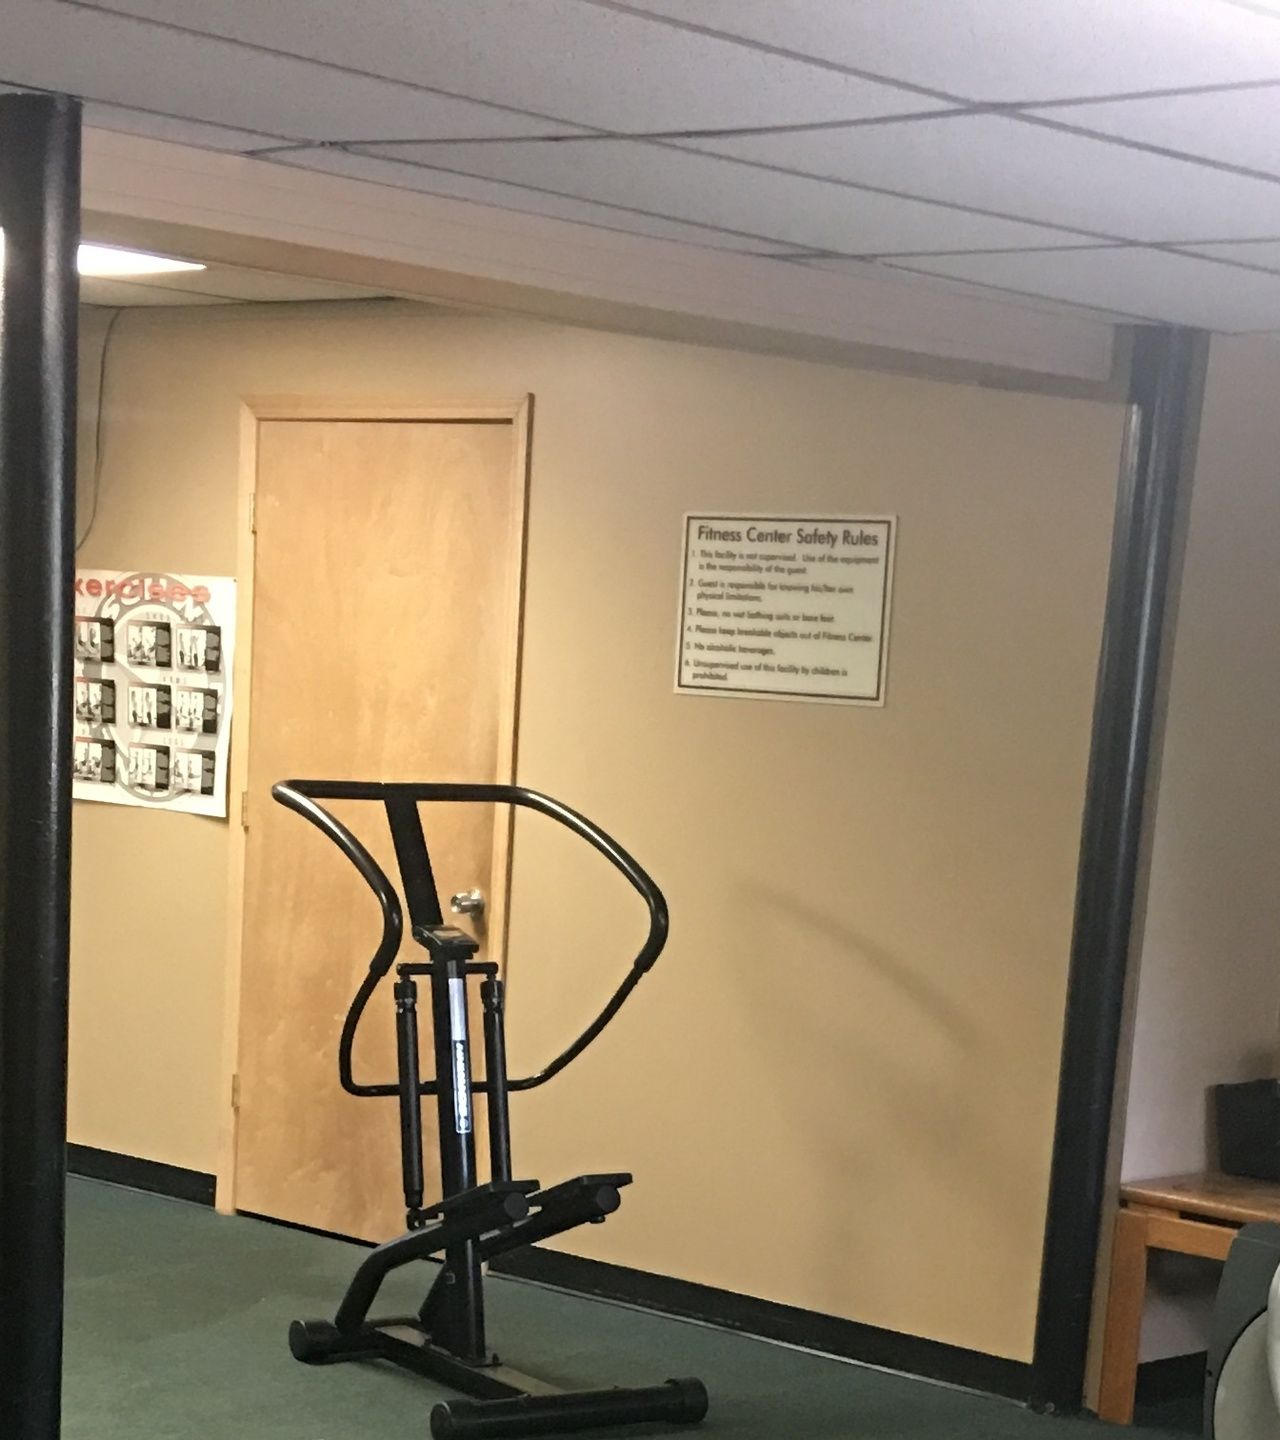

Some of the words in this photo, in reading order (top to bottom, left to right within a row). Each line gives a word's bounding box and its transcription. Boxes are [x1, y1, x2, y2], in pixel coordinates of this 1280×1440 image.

[698, 525, 742, 542] Fitness
[746, 526, 792, 544] Center
[797, 528, 838, 548] Safety
[842, 529, 879, 546] Rules
[700, 549, 713, 558] This
[715, 550, 737, 561] facility
[802, 554, 816, 562] Use
[818, 554, 825, 562] of
[827, 554, 838, 563] the
[840, 556, 879, 565] equipment
[706, 562, 717, 570] the
[719, 563, 763, 574] responsibility
[765, 564, 773, 572] of
[774, 565, 785, 573] the
[698, 578, 718, 588] Guest
[727, 581, 765, 591] responsible
[767, 582, 777, 590] for
[779, 583, 809, 594] knowing
[696, 591, 724, 601] physical
[719, 626, 736, 636] keep
[773, 629, 798, 639] objects
[813, 631, 821, 639] of
[822, 631, 846, 641] Fitness
[694, 642, 705, 650] No
[706, 642, 736, 652] alcoholic
[693, 659, 739, 670] Unsupervised
[754, 662, 761, 671] of
[777, 664, 799, 675] facility
[801, 665, 809, 676] by
[811, 666, 840, 676] children
[841, 668, 848, 676] is
